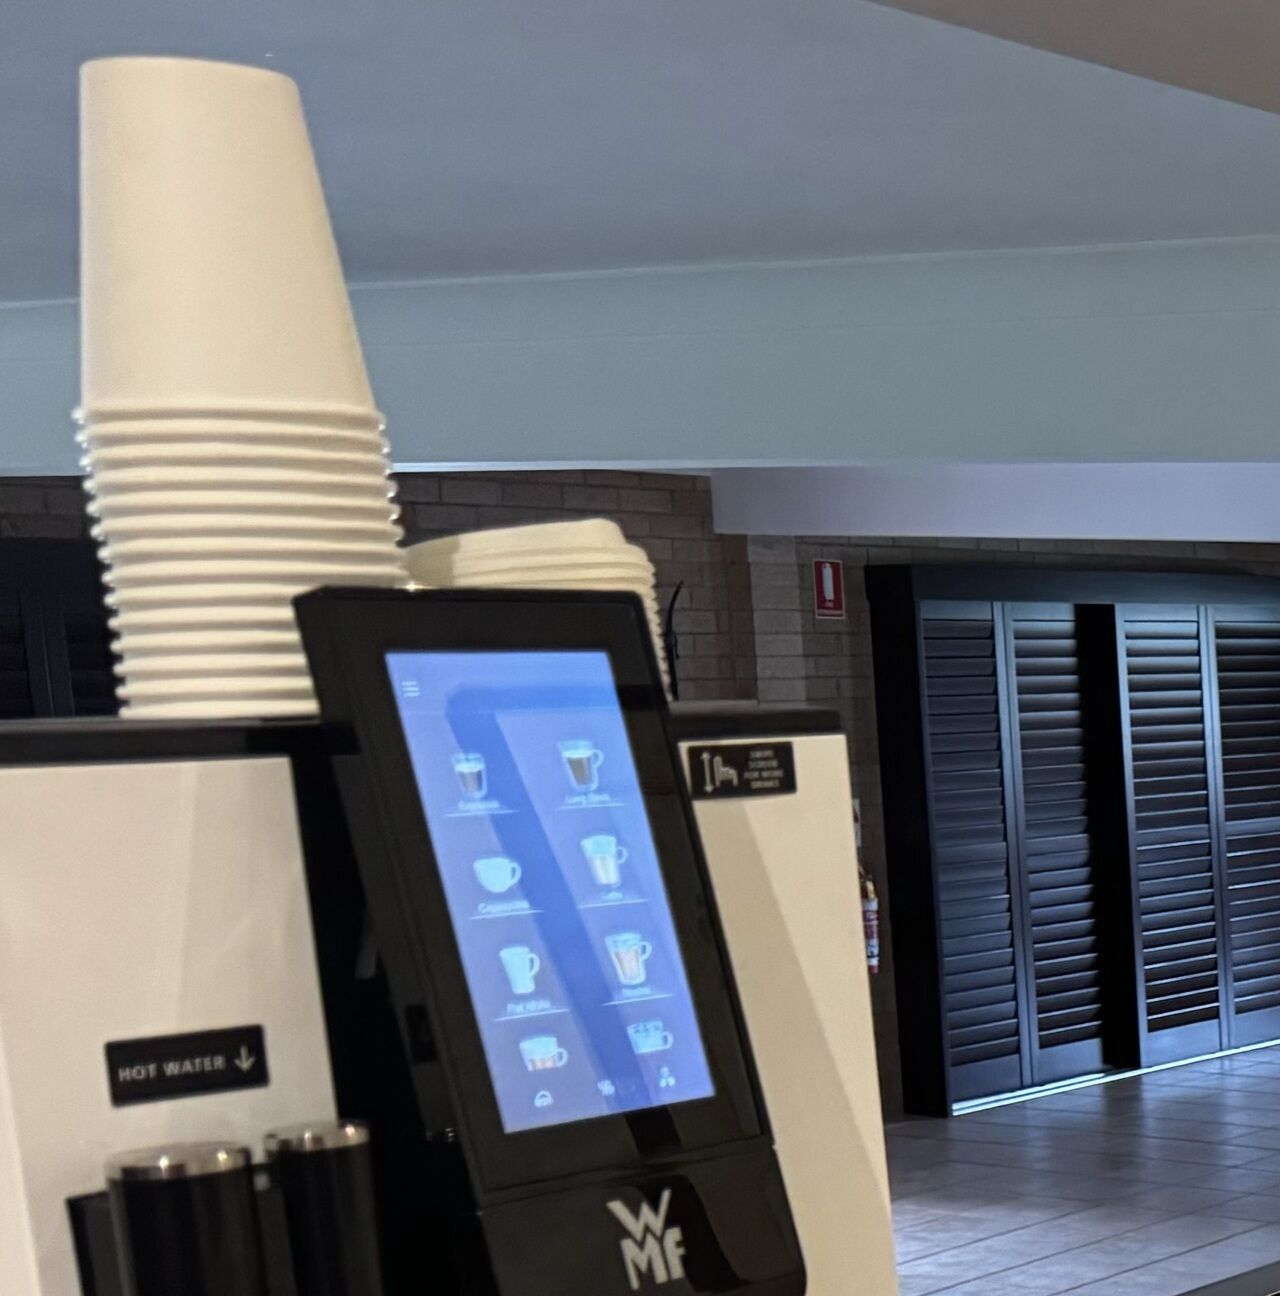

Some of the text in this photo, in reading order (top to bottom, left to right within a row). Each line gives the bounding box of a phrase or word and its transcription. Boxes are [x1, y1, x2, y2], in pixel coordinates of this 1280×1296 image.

[118, 1054, 226, 1082] HOT WATER
[605, 1187, 686, 1291] WMF
